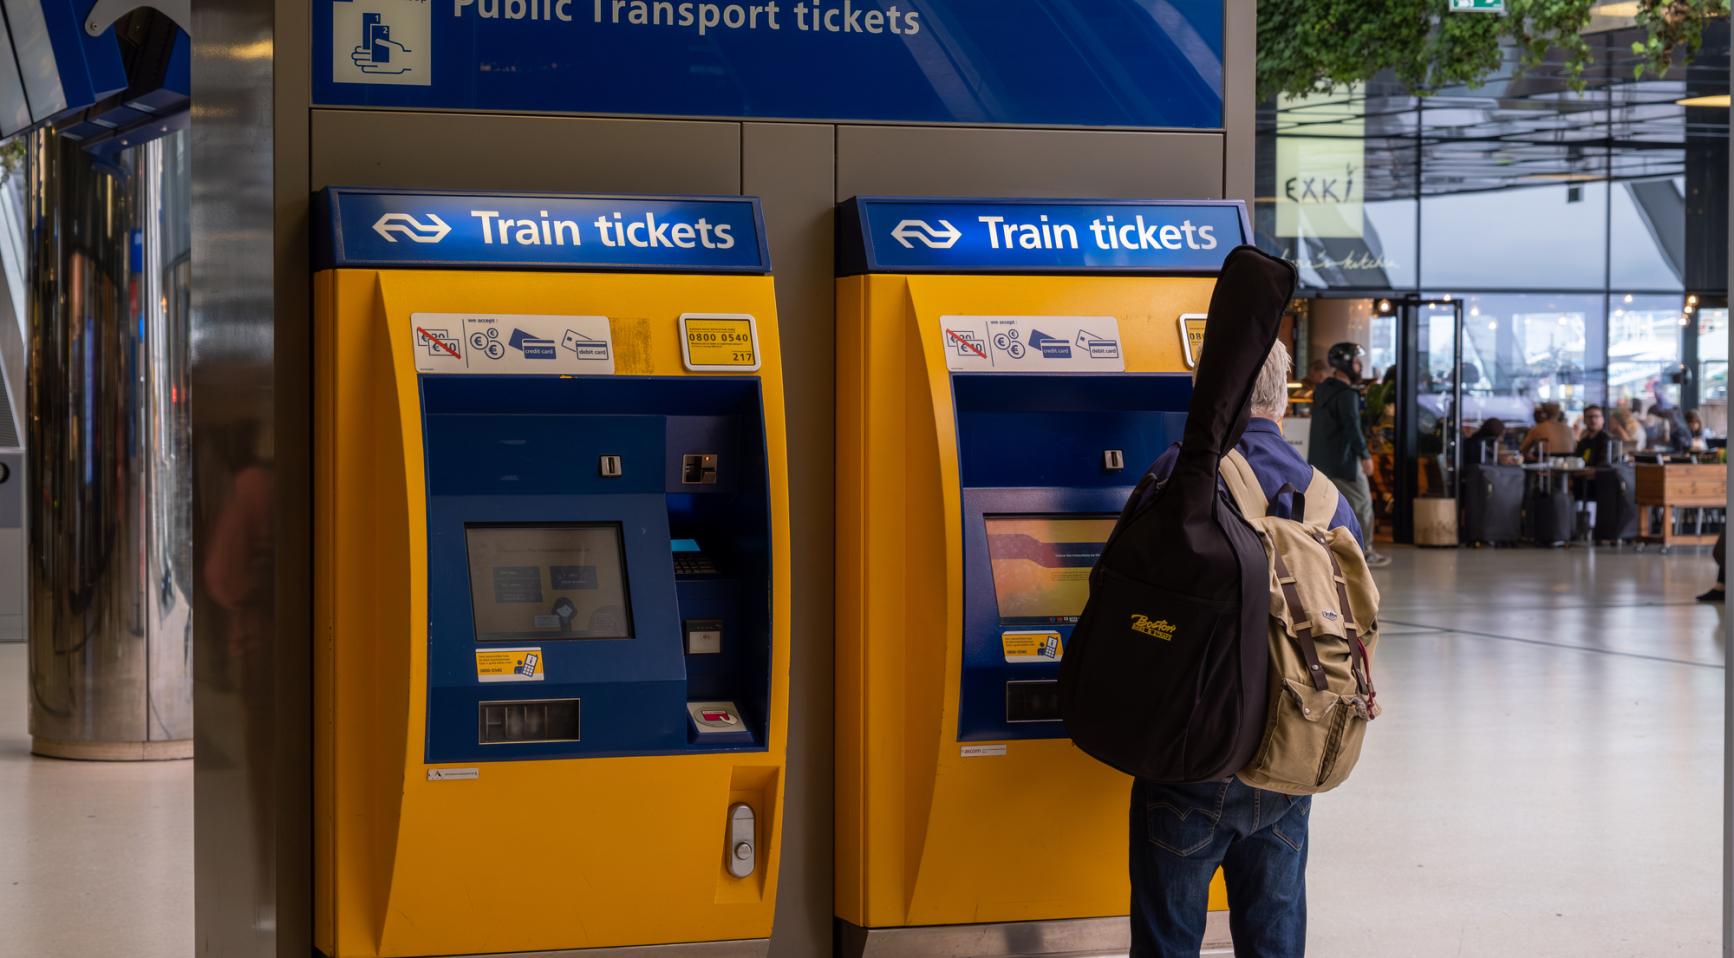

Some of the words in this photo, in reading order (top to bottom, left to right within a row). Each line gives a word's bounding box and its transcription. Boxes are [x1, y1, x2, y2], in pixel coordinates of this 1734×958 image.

[453, 0, 573, 22] Public
[793, 0, 920, 35] tickets
[470, 210, 581, 246] Train
[594, 212, 735, 249] tickets
[978, 215, 1079, 249] Train
[1089, 215, 1218, 250] tickets
[689, 333, 717, 342] 0800
[721, 333, 749, 342] 0540
[732, 352, 752, 361] 217
